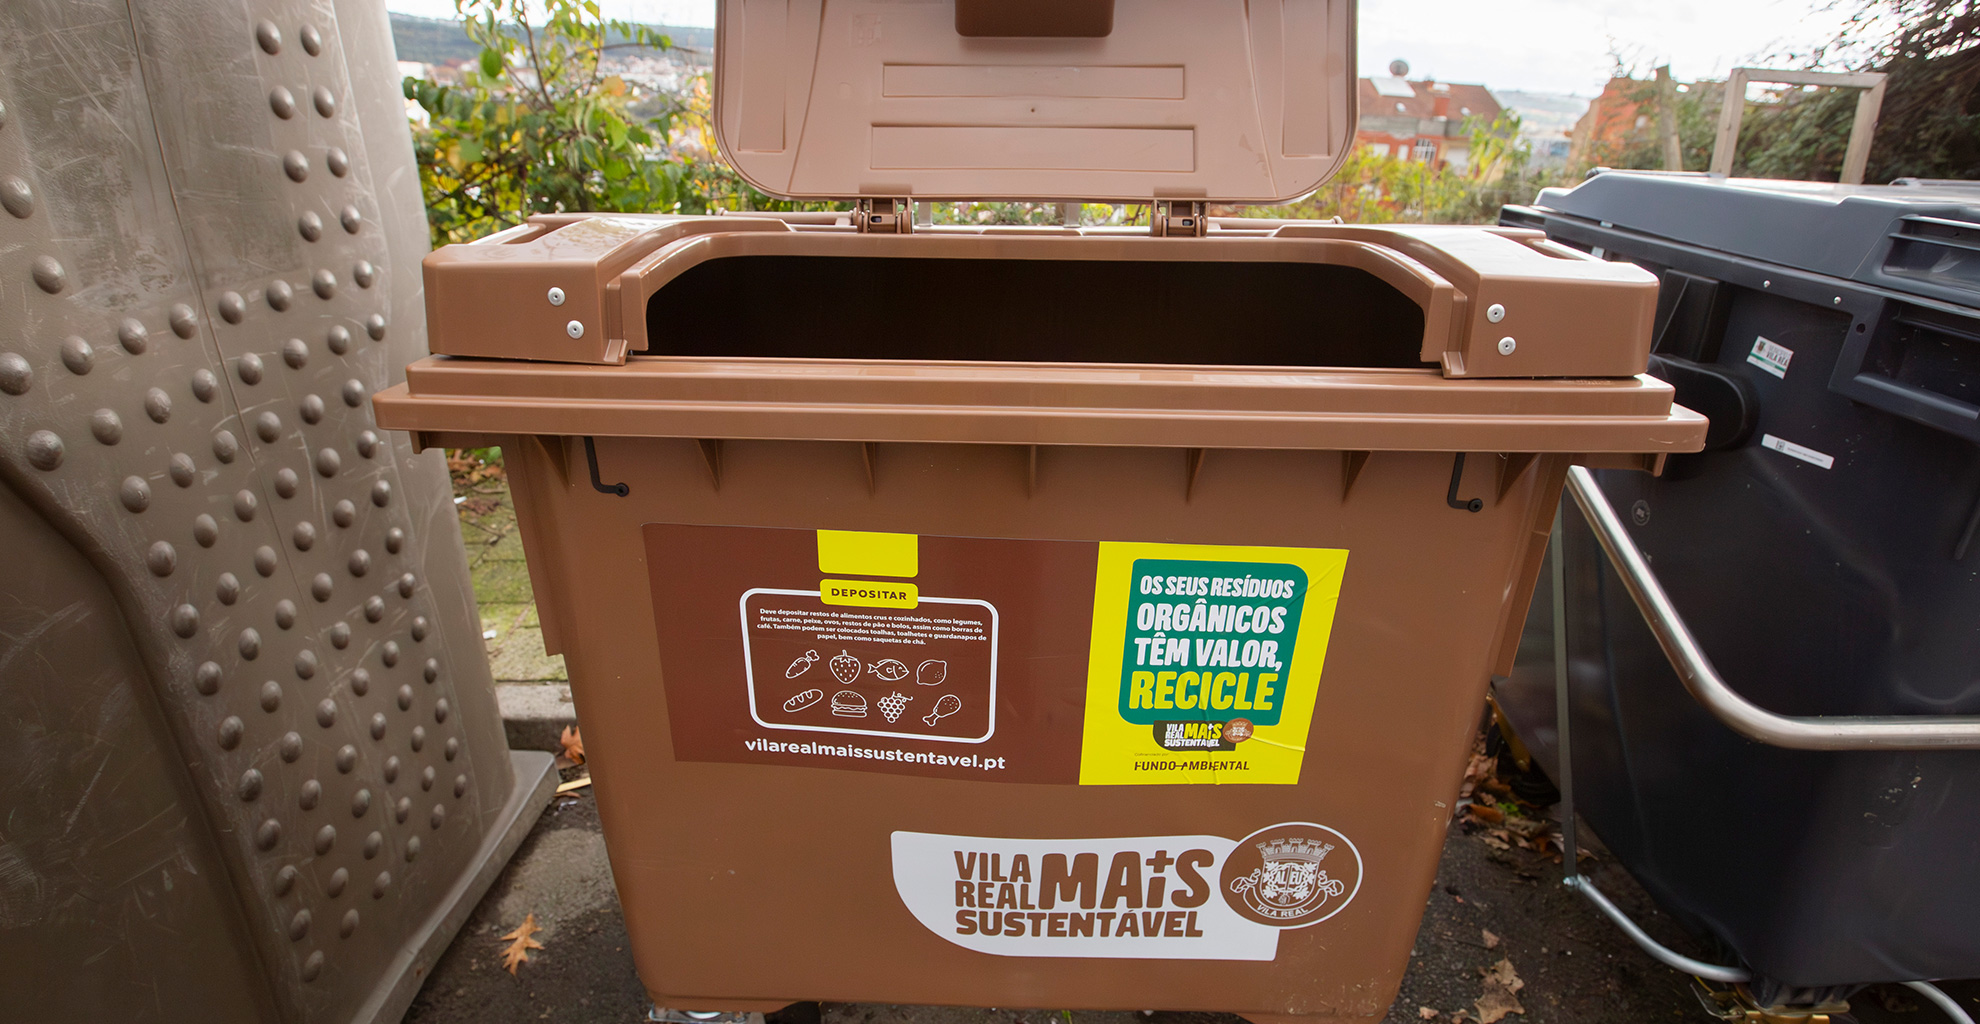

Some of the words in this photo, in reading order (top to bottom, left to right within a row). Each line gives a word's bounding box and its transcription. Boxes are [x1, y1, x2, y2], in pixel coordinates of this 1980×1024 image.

[831, 588, 907, 600] DEPOSITAR
[1140, 576, 1163, 594] OS
[1164, 576, 1209, 596] SEUS
[1210, 574, 1295, 599] RESÍDUOS
[1136, 598, 1288, 634] ORGÂNICOS
[934, 632, 977, 641] guardanapos
[1134, 632, 1190, 666] TÊM
[1196, 639, 1282, 672] VALOR,
[1129, 671, 1278, 710] RECICLE
[1166, 724, 1184, 732] VILA
[745, 739, 1006, 770] vilarealmaissustentavel.pt
[1134, 761, 1176, 771] FUNDO
[1181, 761, 1249, 771] AMBIENTAL
[954, 850, 1032, 883] VILA
[1275, 872, 1286, 884] AL
[1290, 871, 1304, 885] EU
[955, 880, 1036, 910] REAL
[955, 909, 1204, 938] SUSTENTÁVEL
[1257, 904, 1277, 917] VILA
[1281, 907, 1308, 917] REAL
